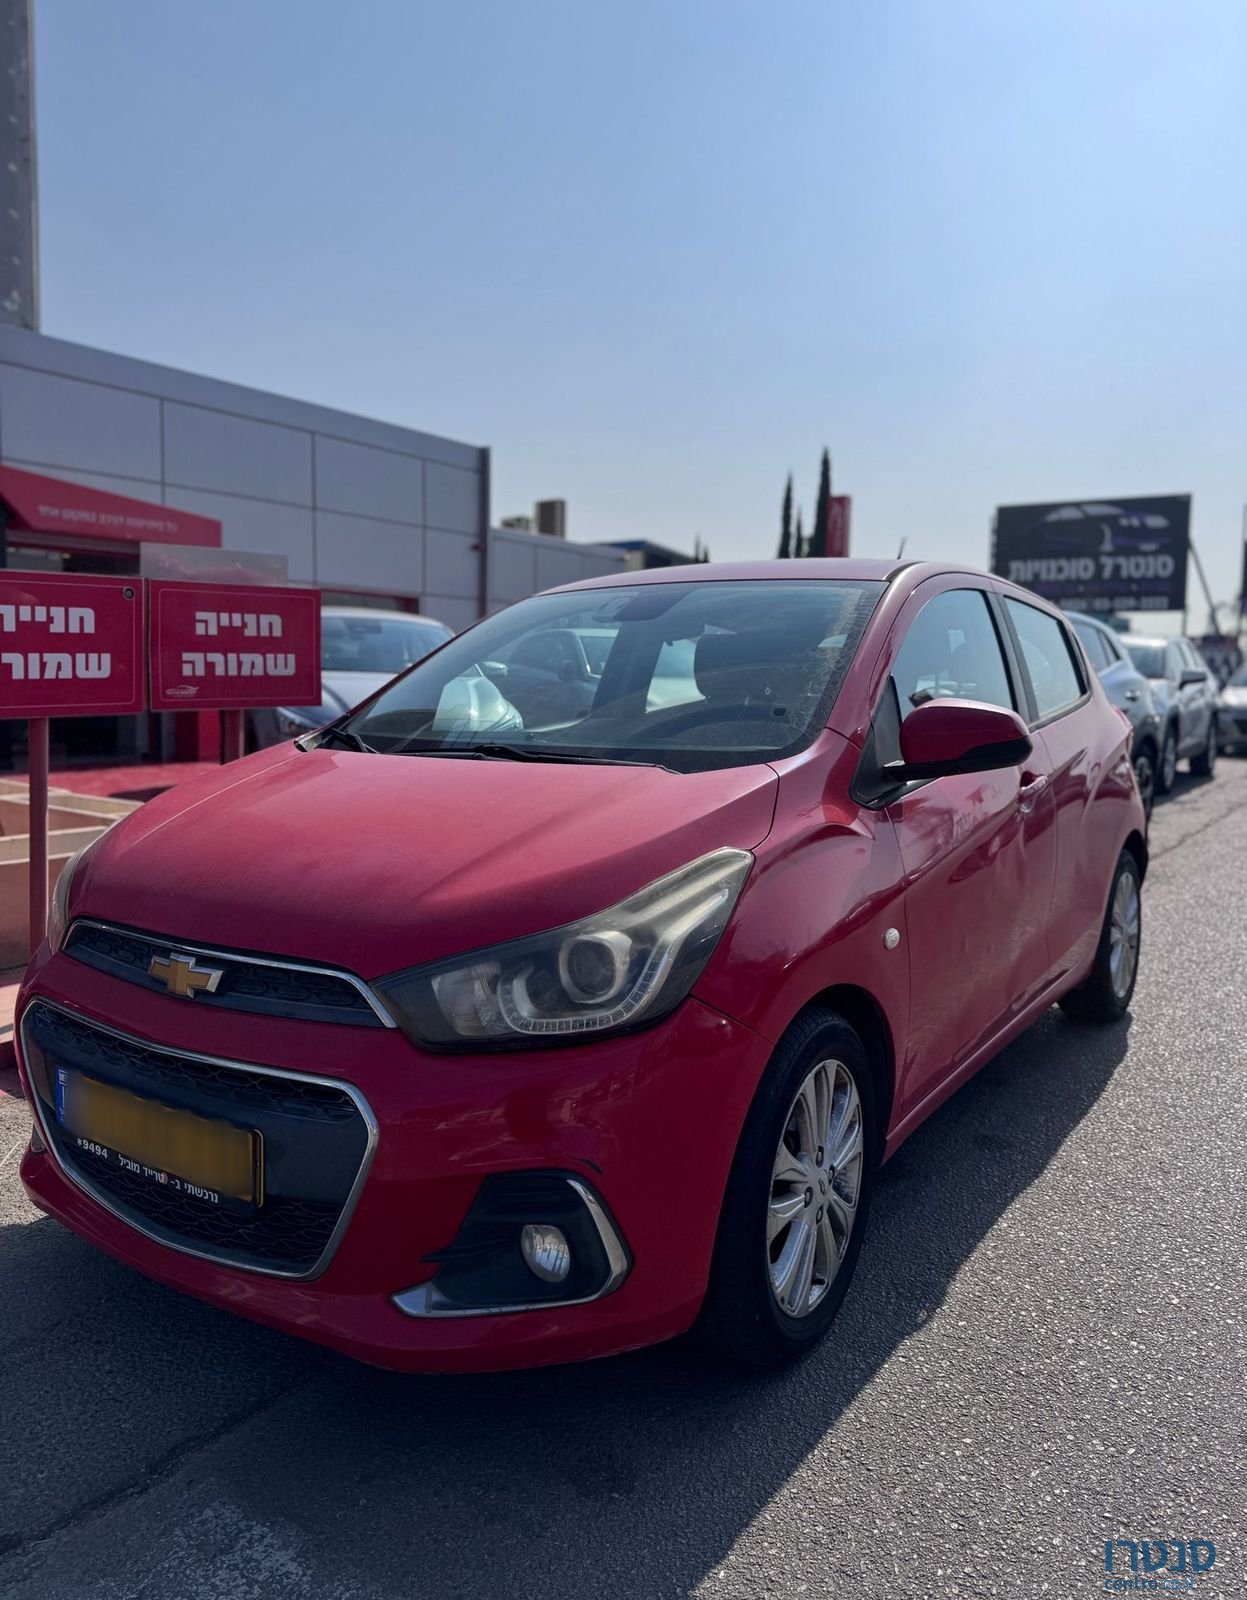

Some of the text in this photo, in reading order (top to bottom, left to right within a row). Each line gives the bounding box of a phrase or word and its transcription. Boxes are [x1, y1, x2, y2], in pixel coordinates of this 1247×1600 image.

[1008, 554, 1175, 581] סנטרל סוכנויות
[195, 611, 283, 638] חנייה
[182, 652, 296, 678] שמורה
[118, 1153, 141, 1174] מוביל
[184, 1182, 219, 1204] נרכשתי
